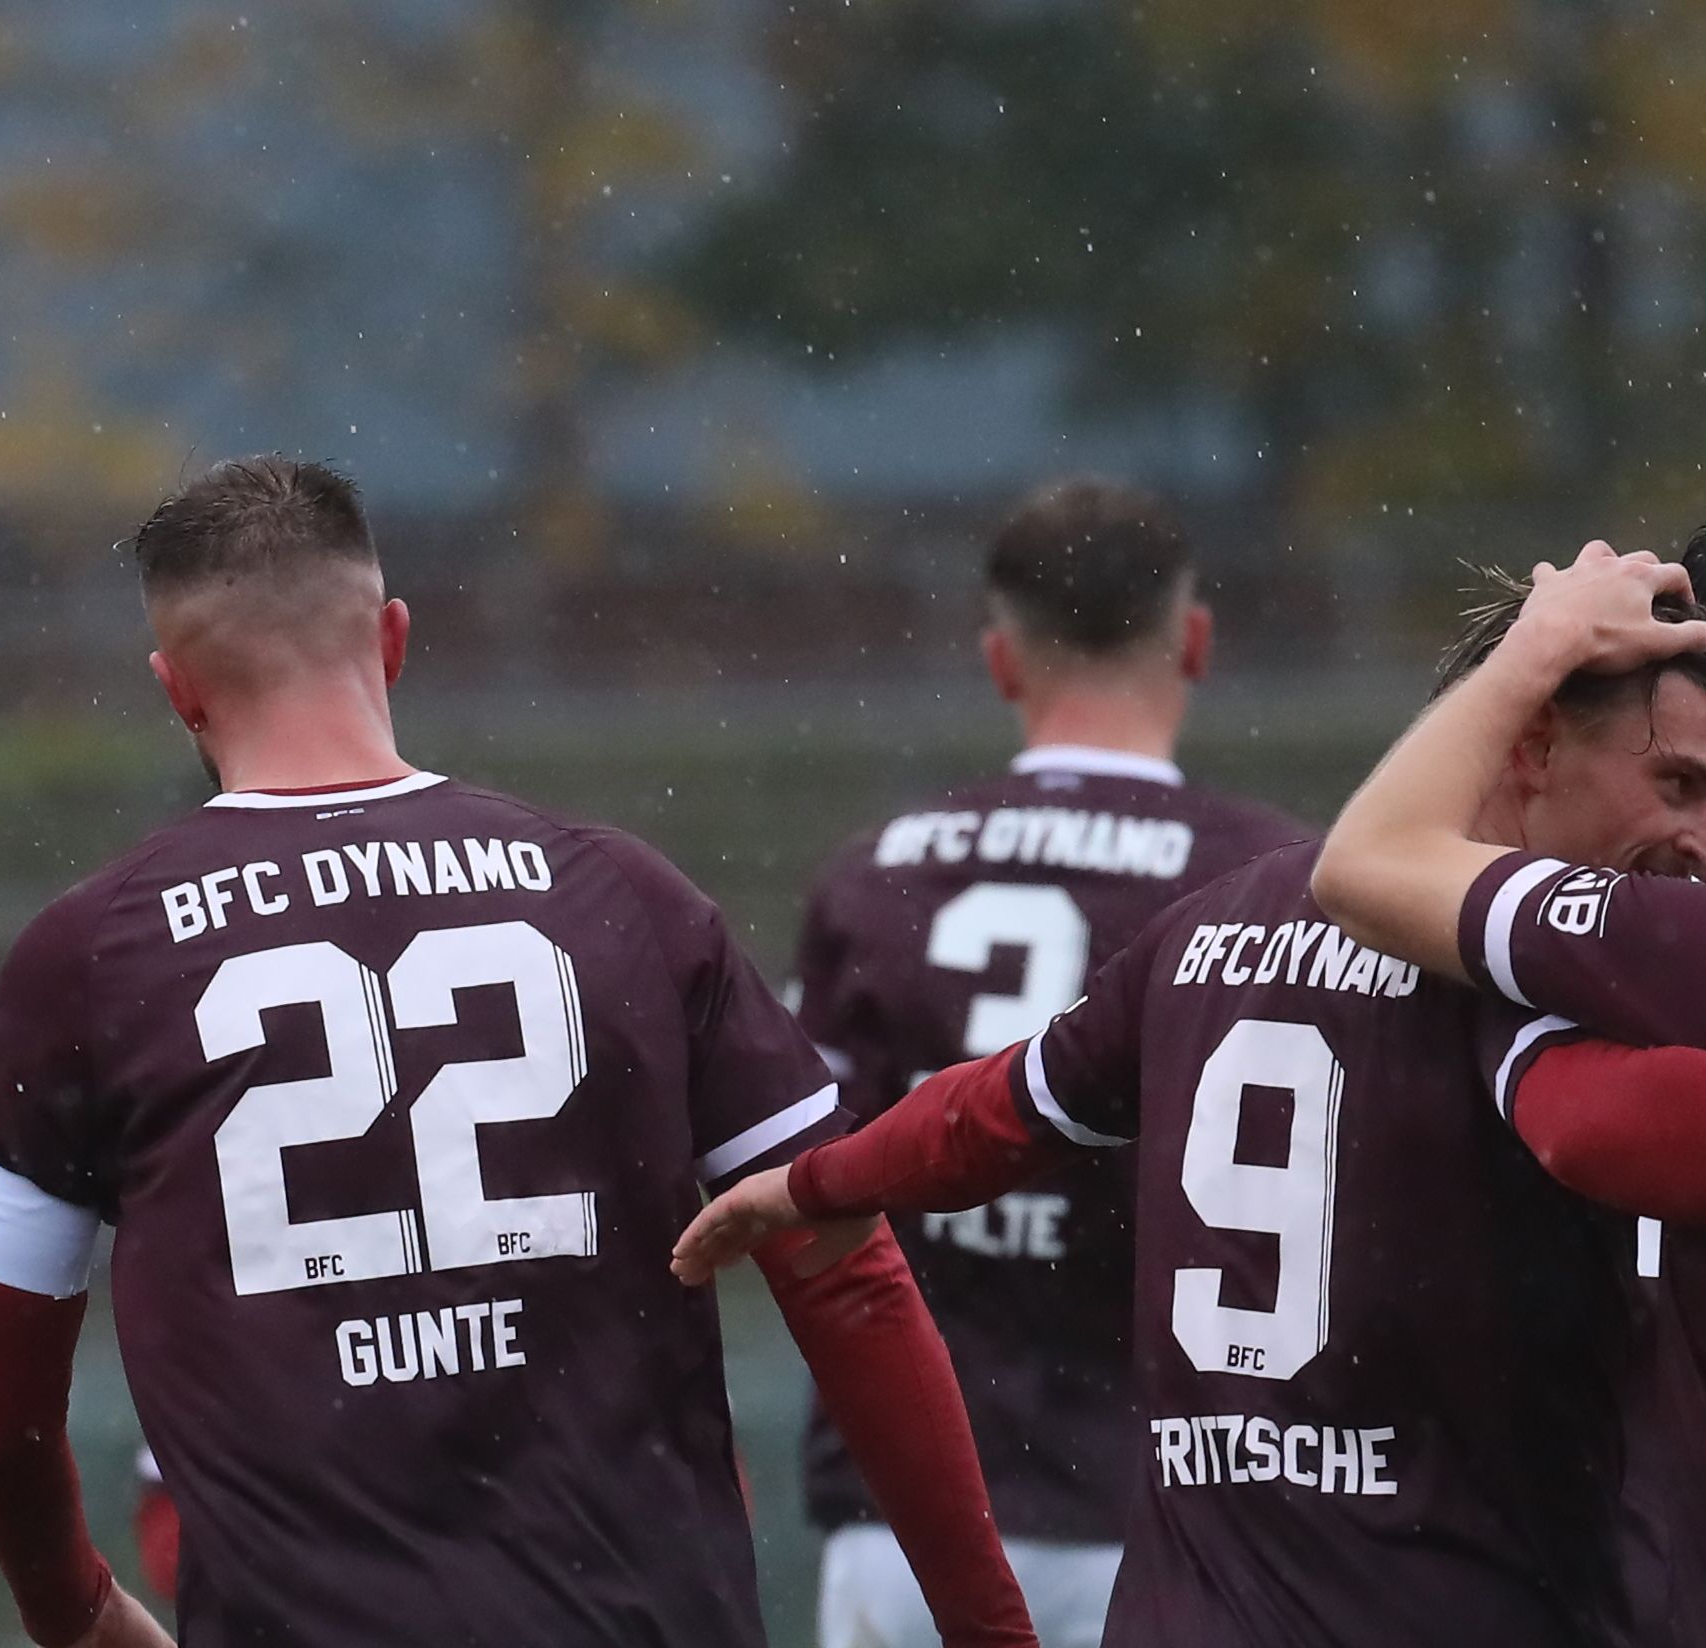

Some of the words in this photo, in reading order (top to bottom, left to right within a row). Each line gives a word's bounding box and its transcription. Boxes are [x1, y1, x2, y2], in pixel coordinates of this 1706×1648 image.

[160, 860, 290, 943] BFC
[301, 837, 552, 907] DYNAMO
[1173, 922, 1266, 986] BFC
[194, 920, 599, 1297] 22
[1172, 1019, 1345, 1381] 9
[304, 1254, 345, 1279] BFC
[498, 1232, 532, 1255] BFC
[335, 1298, 527, 1387] GUNTE
[1226, 1344, 1266, 1371] BFC
